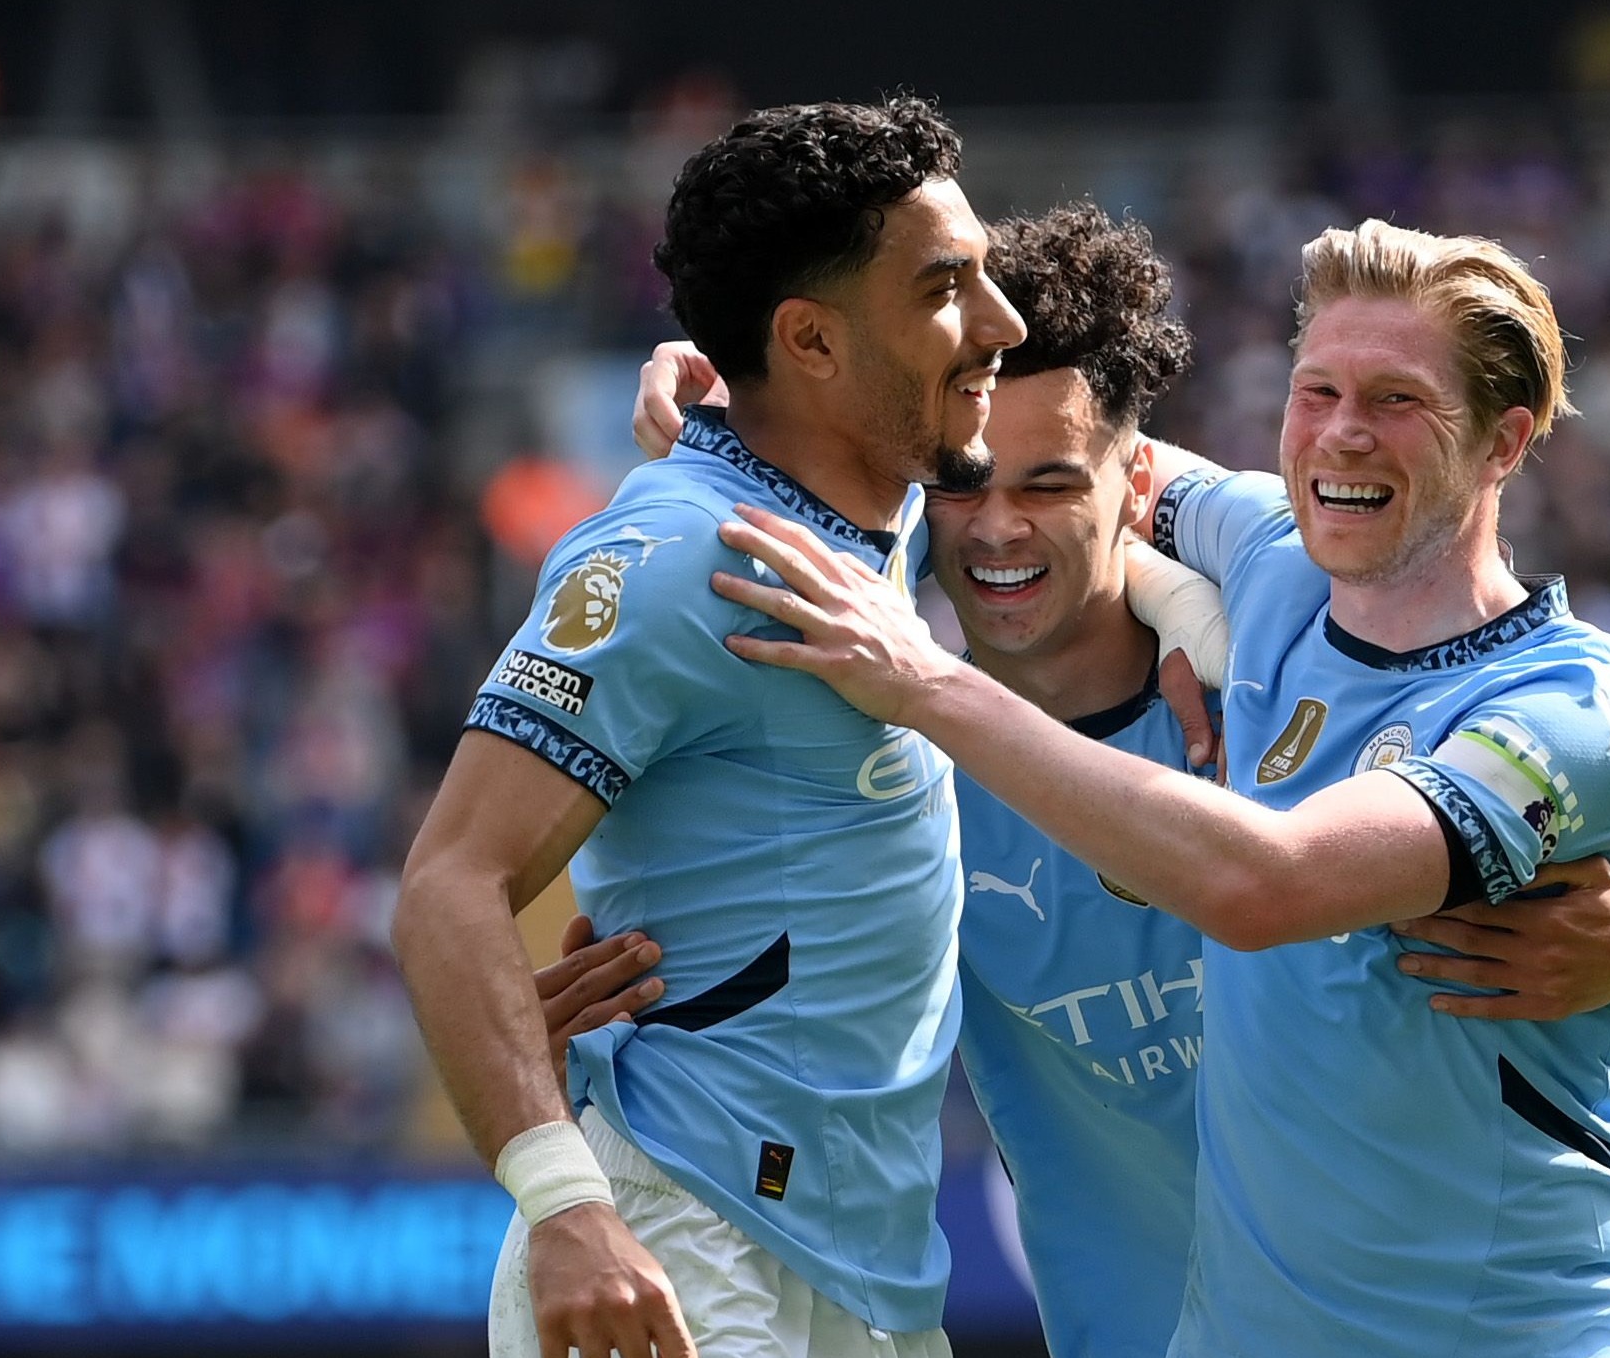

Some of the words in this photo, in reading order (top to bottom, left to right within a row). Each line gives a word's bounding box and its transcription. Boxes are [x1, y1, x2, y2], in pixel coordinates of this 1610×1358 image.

[503, 650, 529, 671] No
[525, 658, 582, 694] room
[514, 674, 583, 716] racism
[1269, 754, 1294, 772] FIFA
[1003, 957, 1204, 1047] TIH
[1091, 1035, 1203, 1086] AIRW
